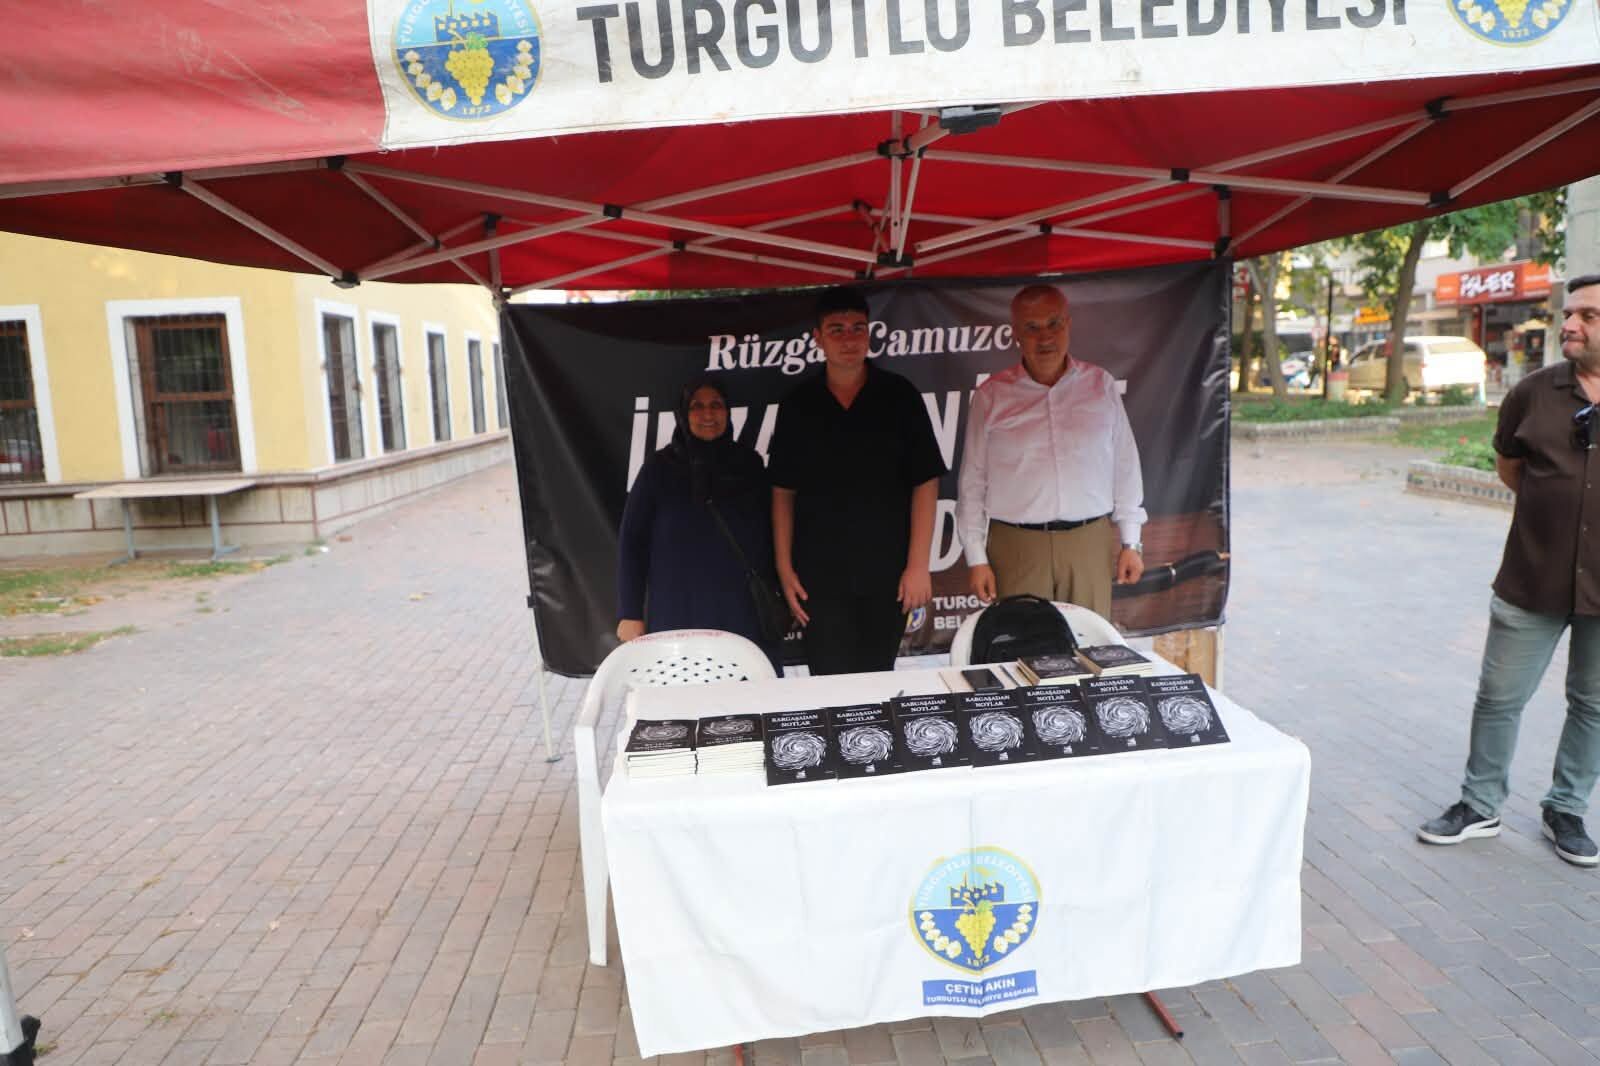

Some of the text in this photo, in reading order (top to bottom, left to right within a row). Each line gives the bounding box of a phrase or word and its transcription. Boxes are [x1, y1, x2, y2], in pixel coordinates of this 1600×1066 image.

[704, 320, 1021, 375] Rüzga Camuzc
[945, 977, 1016, 996] ÇETİN AKIN
